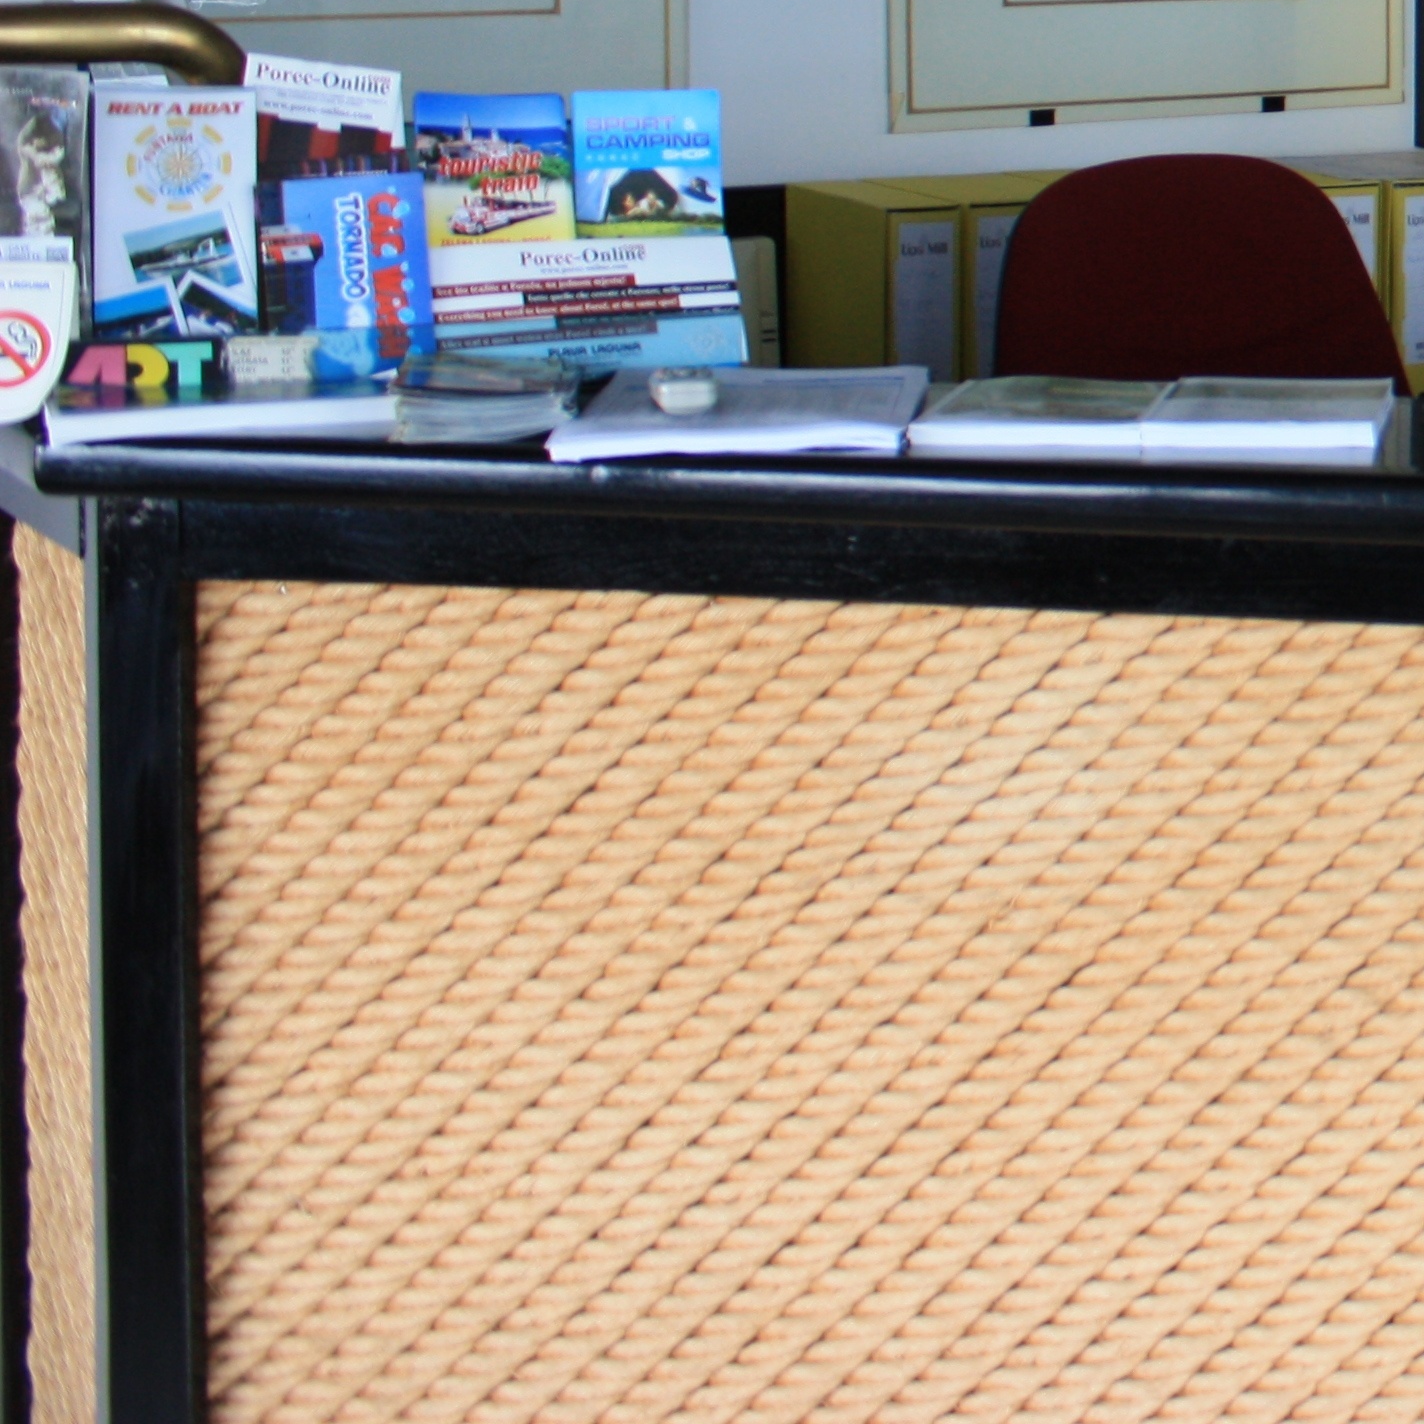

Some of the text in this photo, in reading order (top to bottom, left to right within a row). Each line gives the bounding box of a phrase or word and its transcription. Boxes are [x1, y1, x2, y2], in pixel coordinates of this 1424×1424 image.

[107, 101, 245, 115] RENT A BOAT
[586, 116, 697, 132] SPORT &
[586, 132, 710, 150] CAMPING
[661, 148, 711, 161] SHOP
[438, 151, 542, 177] touristic
[481, 174, 540, 195] train
[335, 192, 369, 301] TORNADO
[549, 342, 641, 358] PLAVA LAGUNA
[67, 341, 213, 385] ART
